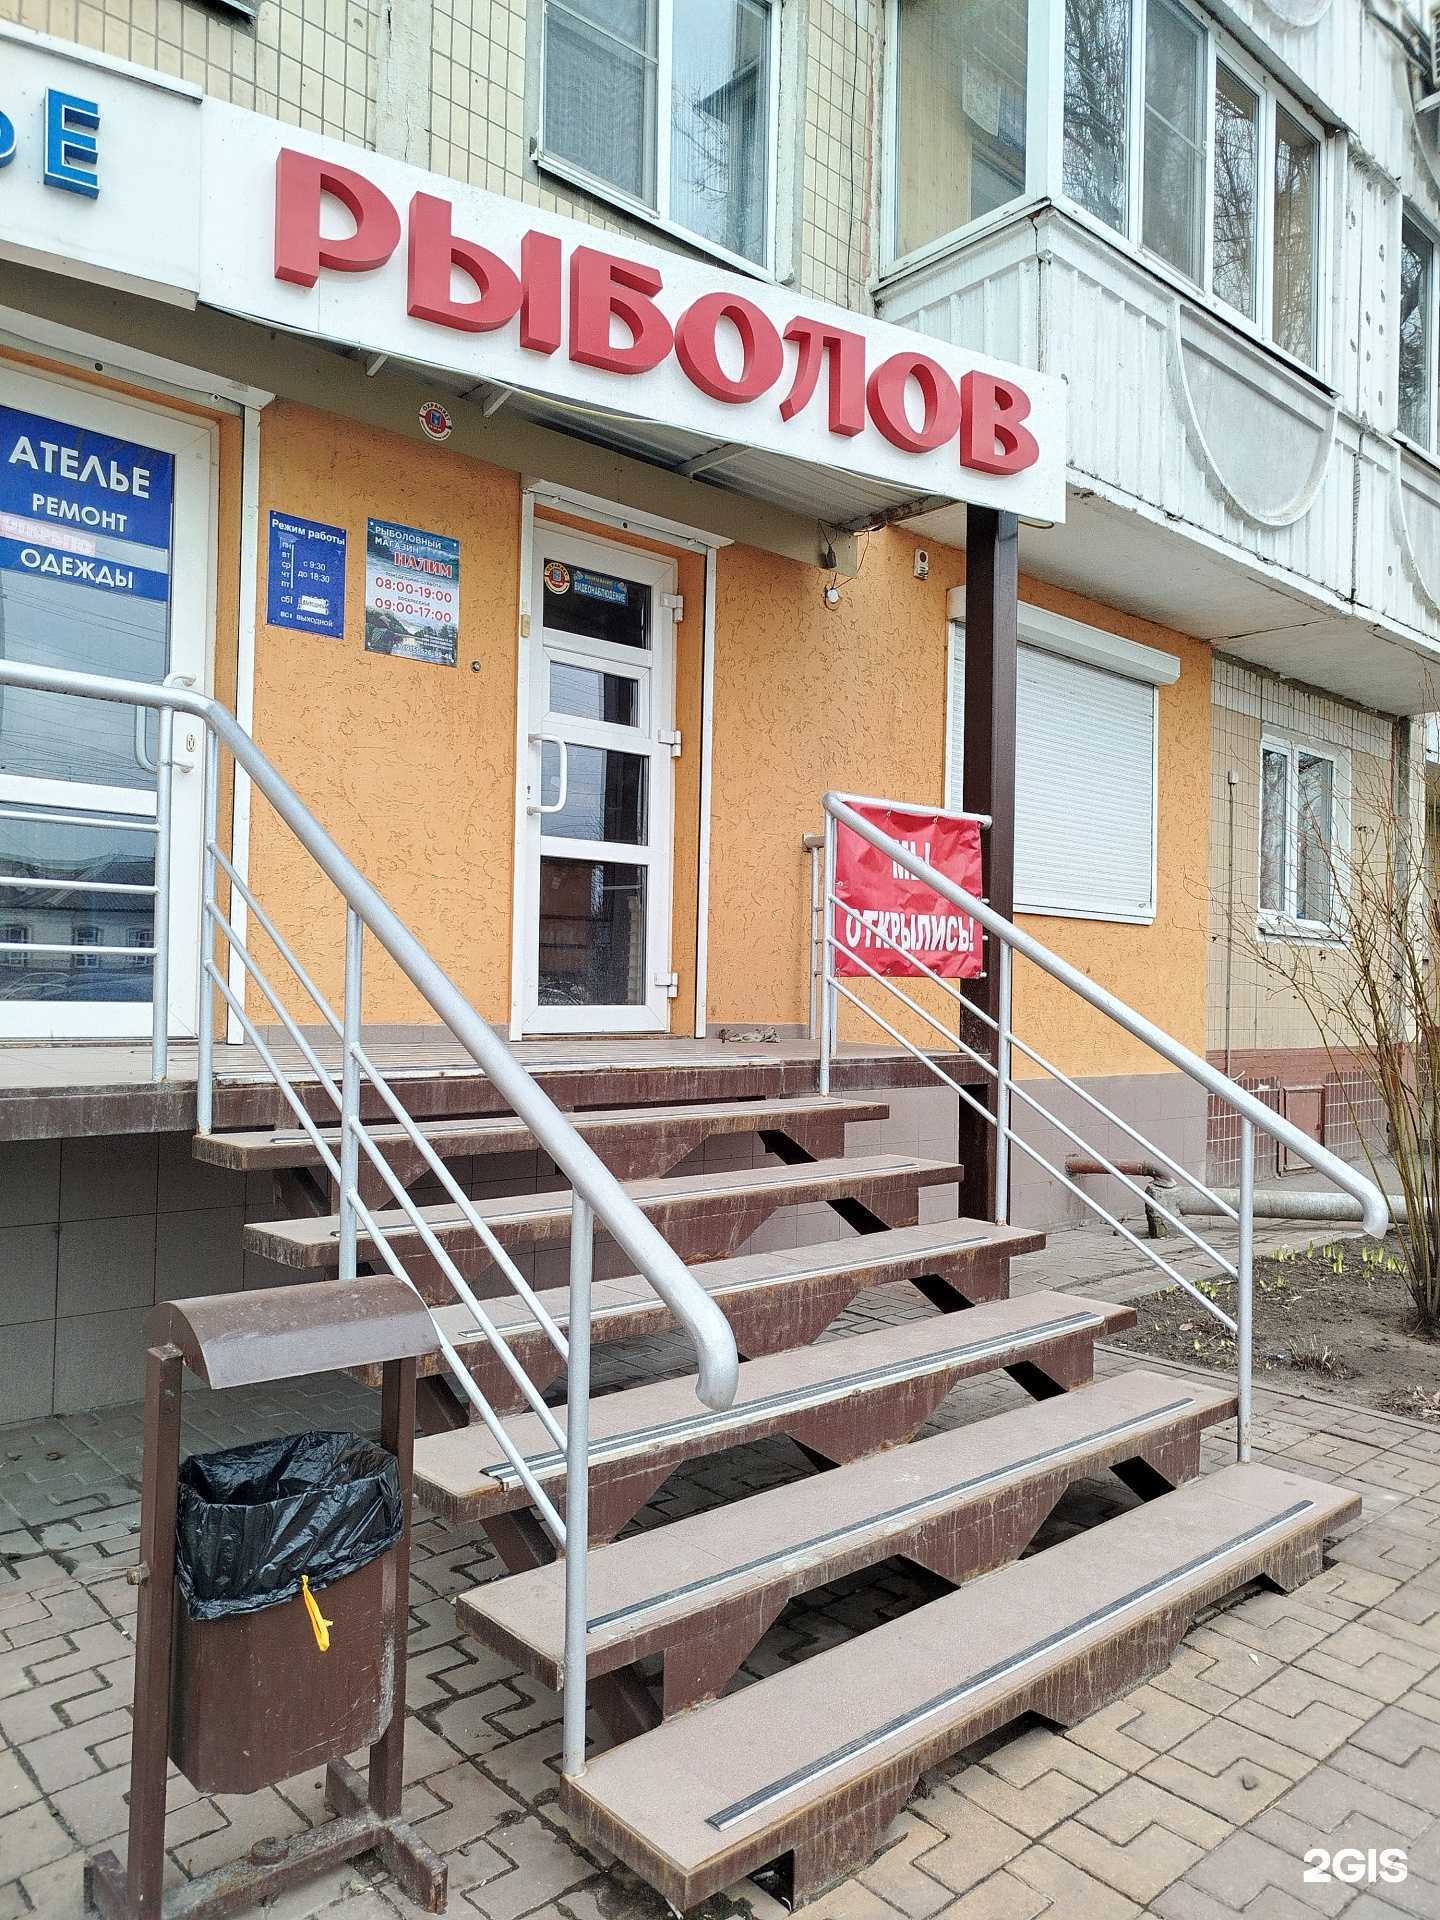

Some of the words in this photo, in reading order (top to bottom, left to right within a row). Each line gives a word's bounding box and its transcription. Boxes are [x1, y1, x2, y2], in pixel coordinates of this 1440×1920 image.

[274, 147, 1040, 475] РЫБОЛОВ
[8, 435, 150, 499] АТЕЛЬЕ
[32, 493, 128, 532] РЕМОНТ
[271, 518, 306, 536] Режим
[308, 529, 345, 546] работы
[375, 526, 442, 550] РЫБОЛОВНЫЙ
[281, 551, 290, 559] вт
[374, 536, 419, 554] МАГАЗИН
[20, 548, 133, 589] ОДЕЖДЫ
[281, 561, 291, 570] ср
[281, 570, 290, 579] чт
[297, 570, 308, 578] до
[309, 571, 330, 584] 18:30
[309, 560, 326, 572] 9:30
[394, 551, 453, 579] НАЛИМ
[281, 580, 290, 588] пт
[375, 576, 452, 603] 08:00-19:00
[574, 581, 627, 604] ВИДЕОНАБЛЮДЕНИЕ
[296, 614, 333, 627] выходной
[375, 597, 452, 623] 09:00-17:00
[845, 908, 975, 952] ОТКРЫЛИСЬ!
